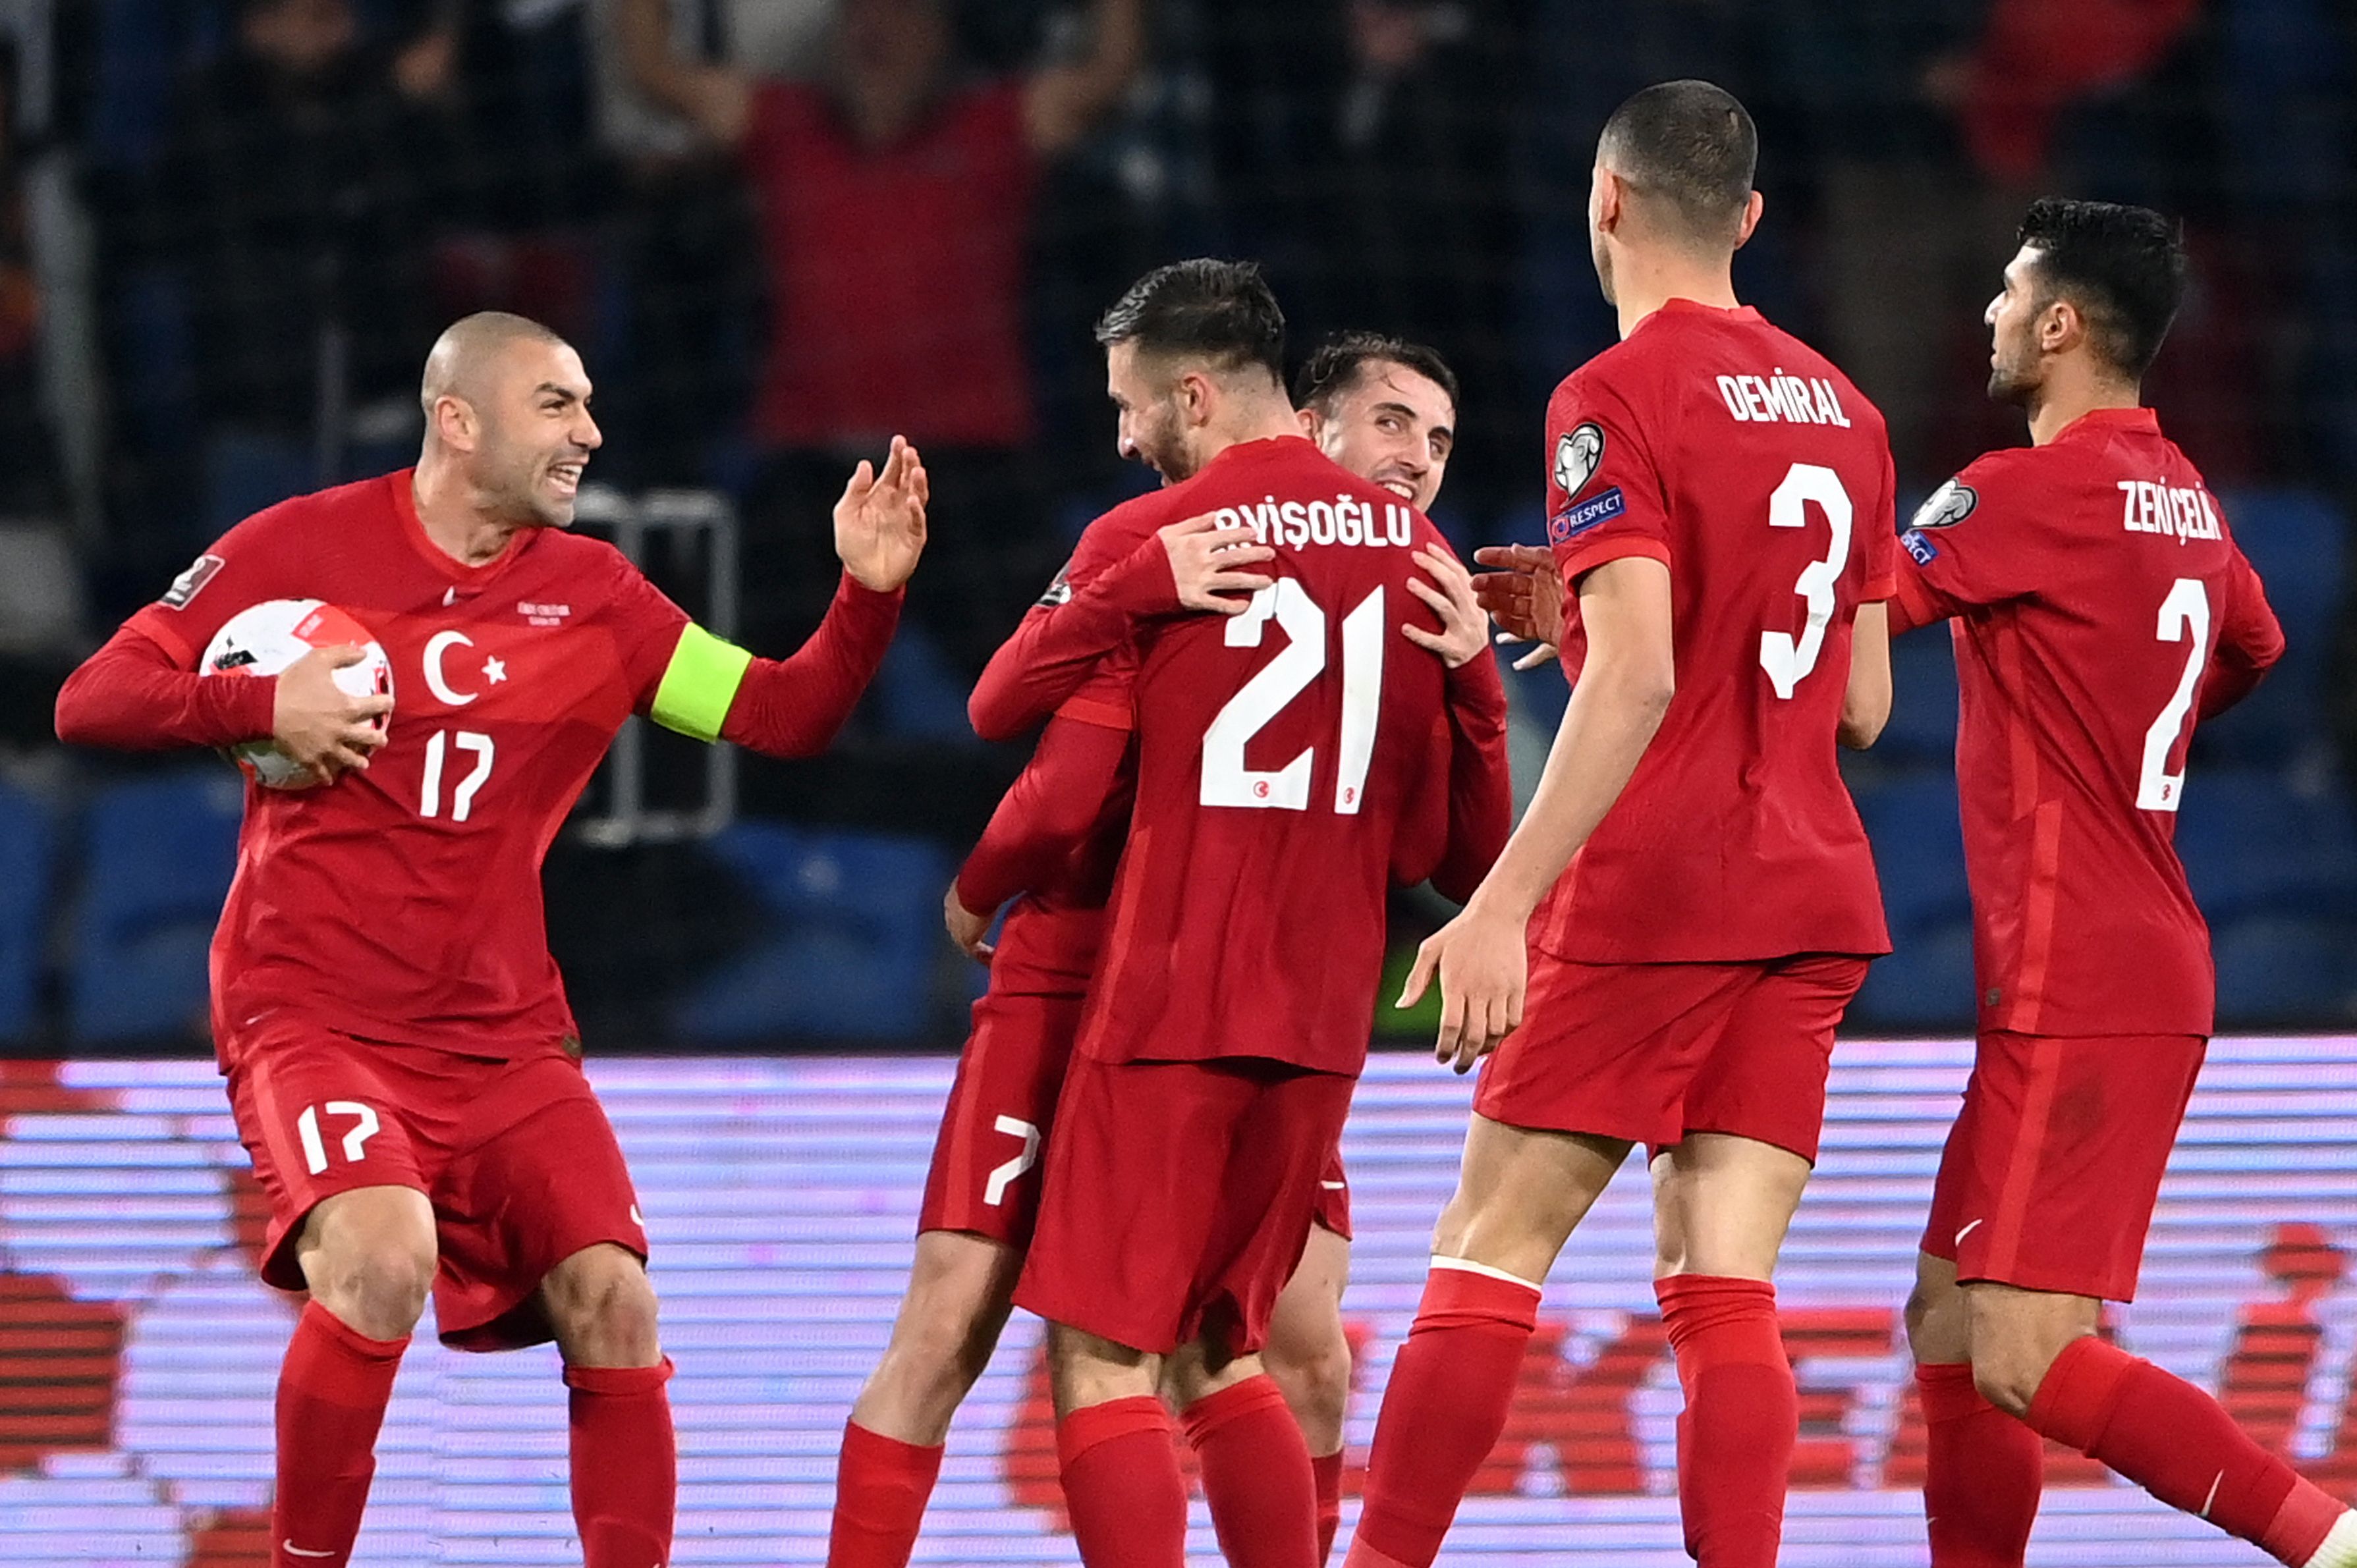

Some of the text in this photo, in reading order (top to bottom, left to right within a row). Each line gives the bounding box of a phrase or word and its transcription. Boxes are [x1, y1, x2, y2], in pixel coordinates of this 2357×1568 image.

[1715, 367, 1851, 428] DEMİRAL
[1216, 493, 1412, 553] RVİŞOĞLU
[1570, 494, 1621, 527] RESPECT
[1760, 462, 1852, 699] 3
[1199, 576, 1385, 815] 21
[2135, 578, 2210, 811] 2
[420, 729, 495, 822] 17
[297, 1100, 380, 1175] 17
[984, 1114, 1041, 1206] 7
